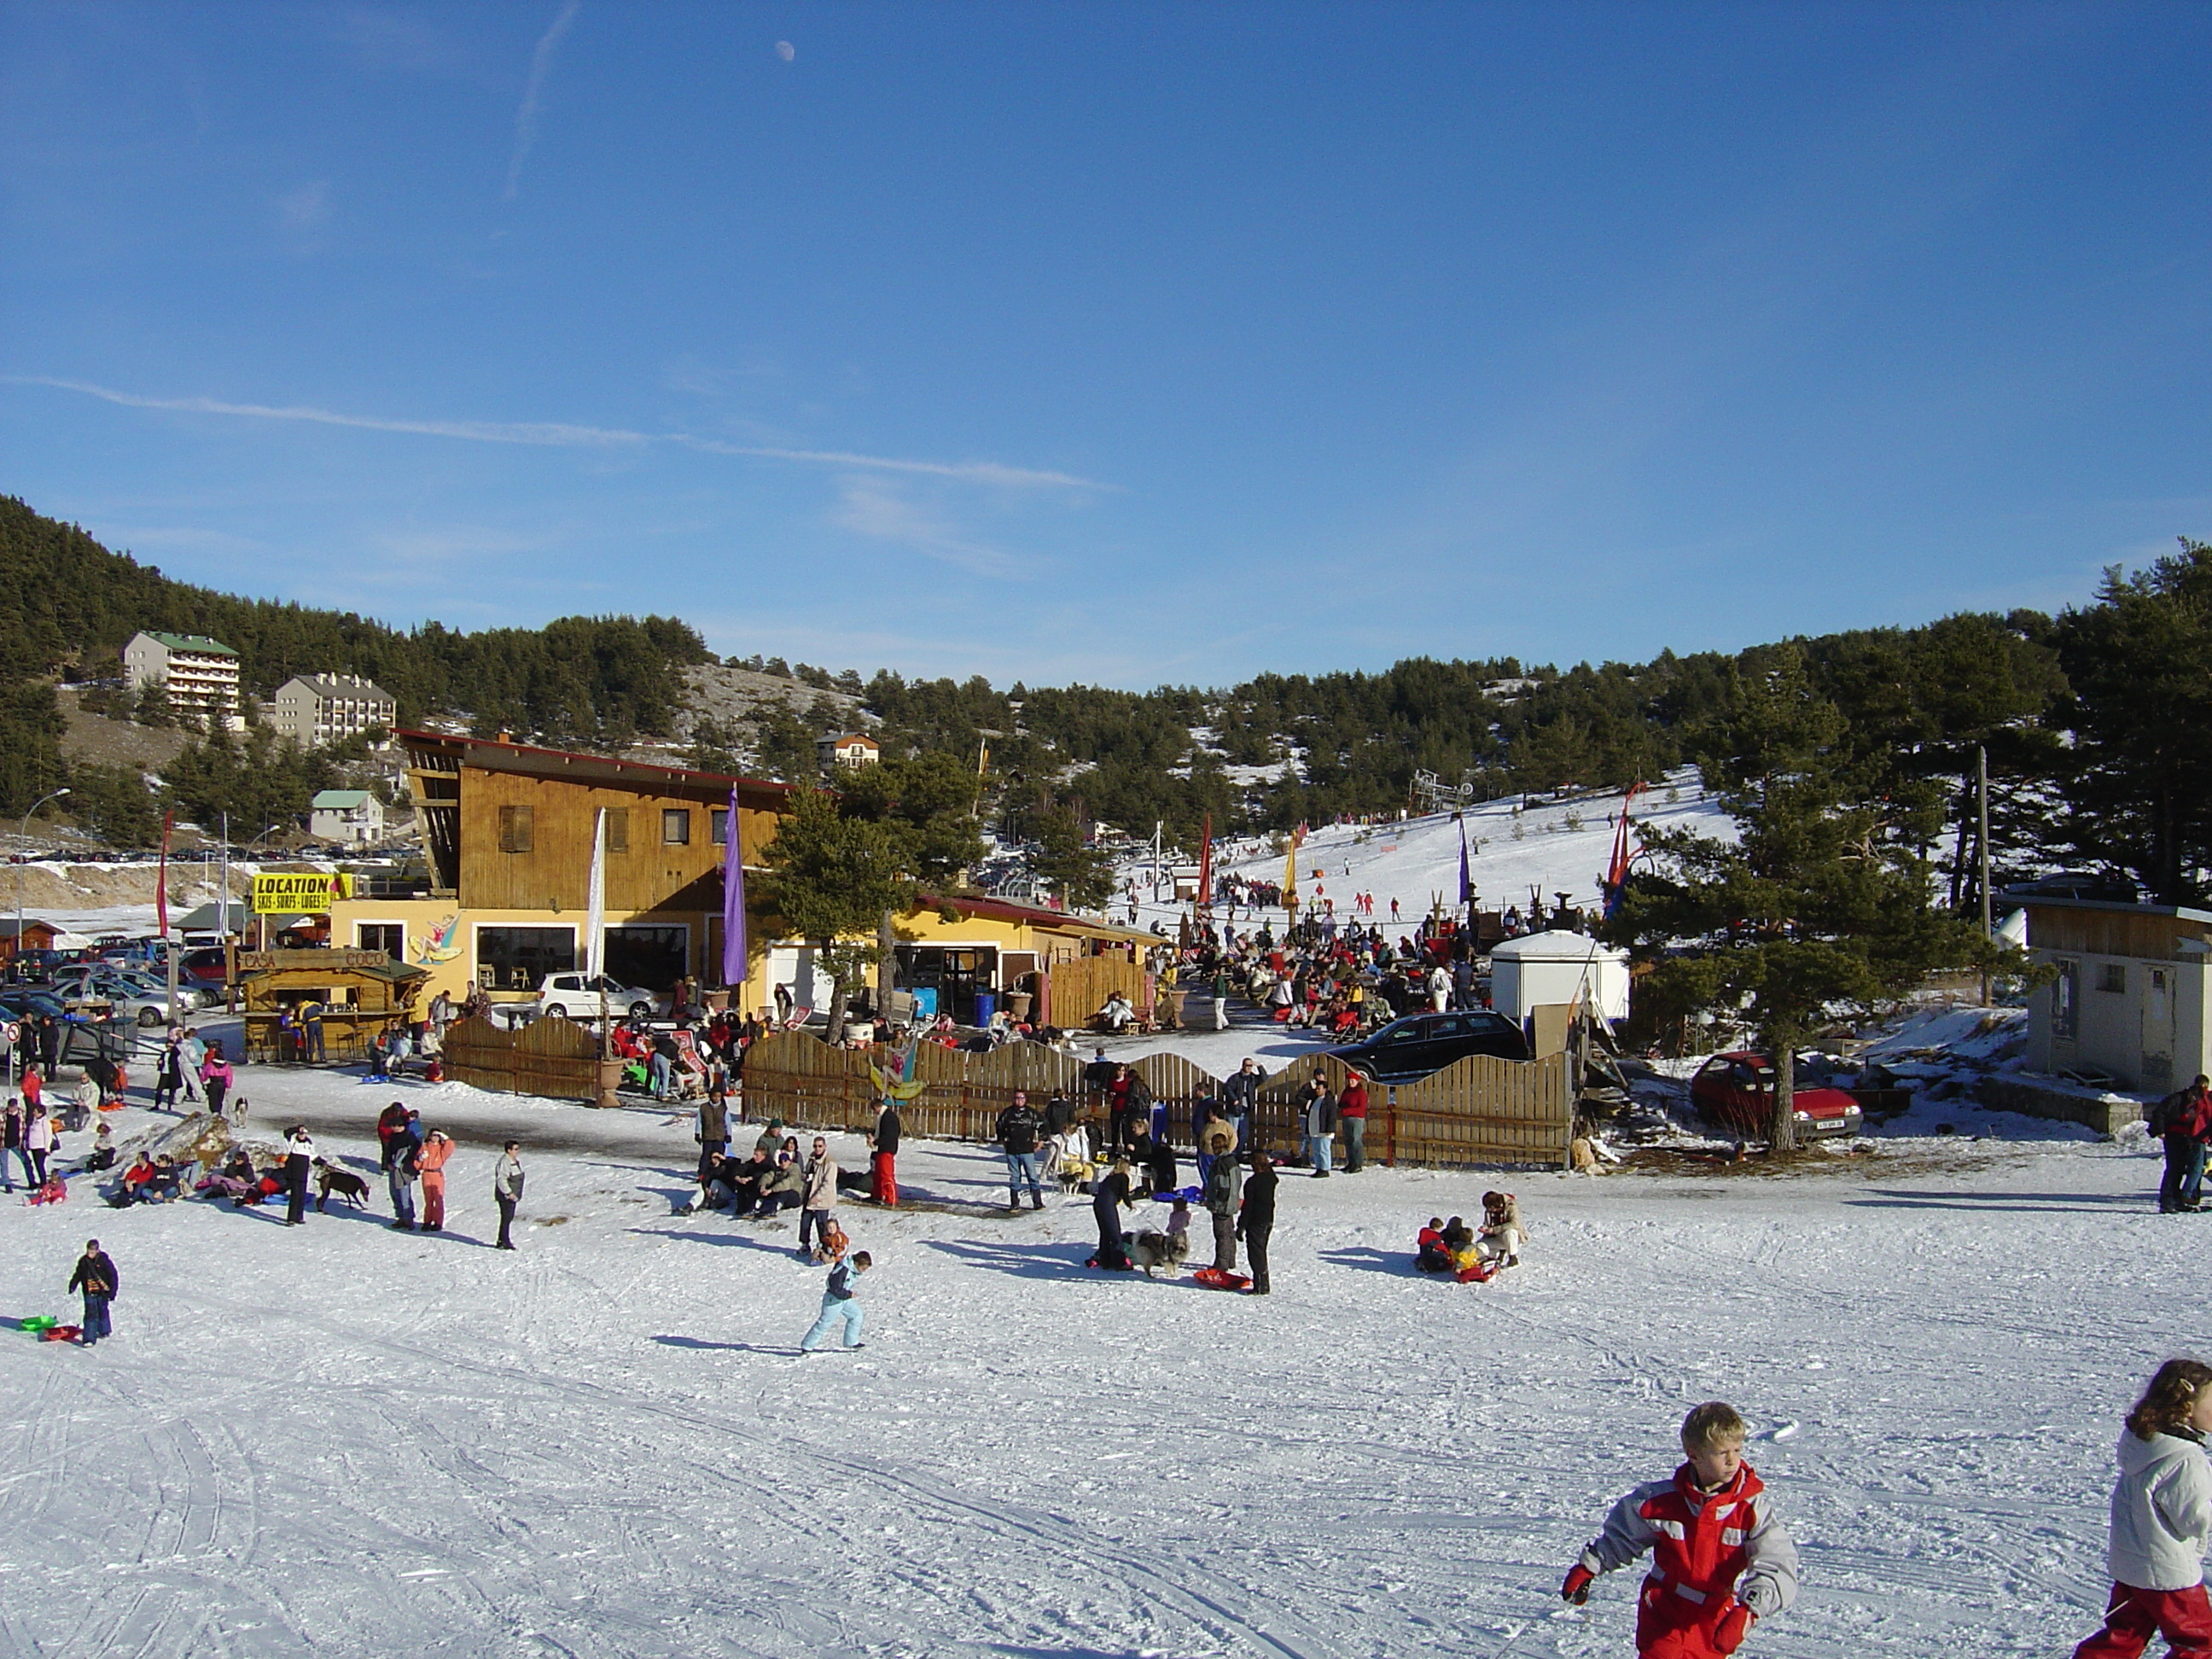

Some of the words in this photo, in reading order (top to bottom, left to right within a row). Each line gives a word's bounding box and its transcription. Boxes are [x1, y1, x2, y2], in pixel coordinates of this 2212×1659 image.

[257, 878, 329, 894] LOCATION
[257, 894, 271, 909] SKIS
[276, 894, 296, 909] SURFS
[301, 894, 320, 909] LUGES
[244, 953, 276, 968] CASA
[346, 952, 384, 966] COCO
